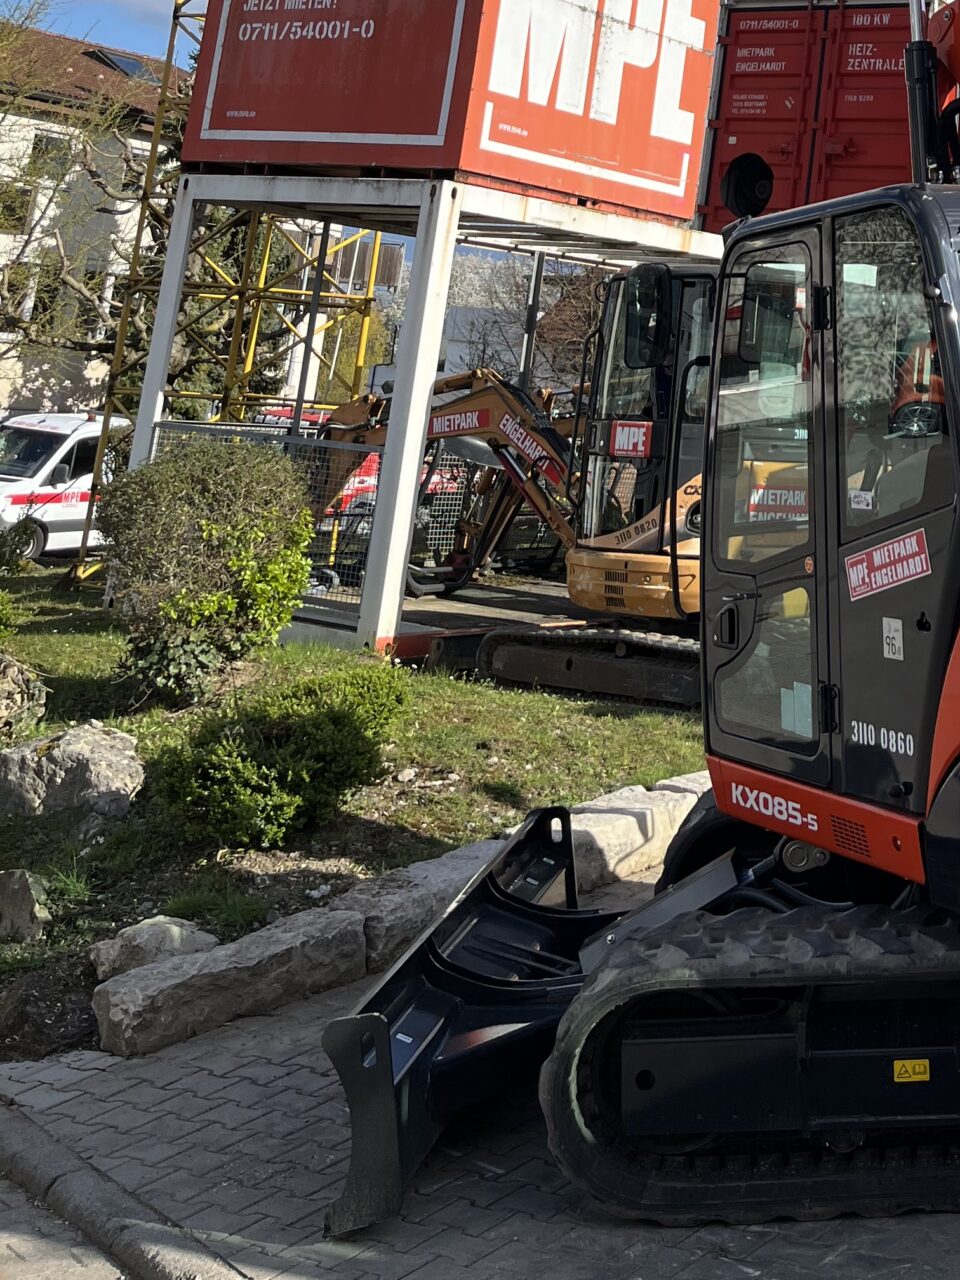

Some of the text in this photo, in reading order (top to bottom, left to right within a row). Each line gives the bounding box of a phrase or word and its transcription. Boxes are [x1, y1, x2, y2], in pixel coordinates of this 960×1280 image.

[239, 19, 375, 41] 0711/54001-0
[739, 20, 799, 30] 0711/54001-0
[737, 47, 775, 58] MIETPARK
[848, 43, 877, 56] HEIZ-
[735, 61, 786, 72] ENGELHARDT
[847, 58, 905, 71] ZENTRALE
[433, 410, 479, 433] MIETPARK
[615, 426, 646, 451] MPE
[750, 488, 806, 506] MIETPARK
[614, 518, 657, 545] 3110 0820
[873, 536, 919, 567] MIETPARK
[849, 562, 869, 588] MPE
[871, 554, 927, 589] ENGELHARDT
[885, 634, 897, 656] 96
[851, 720, 914, 757] 3110 0860
[731, 782, 819, 832] KX085-5
